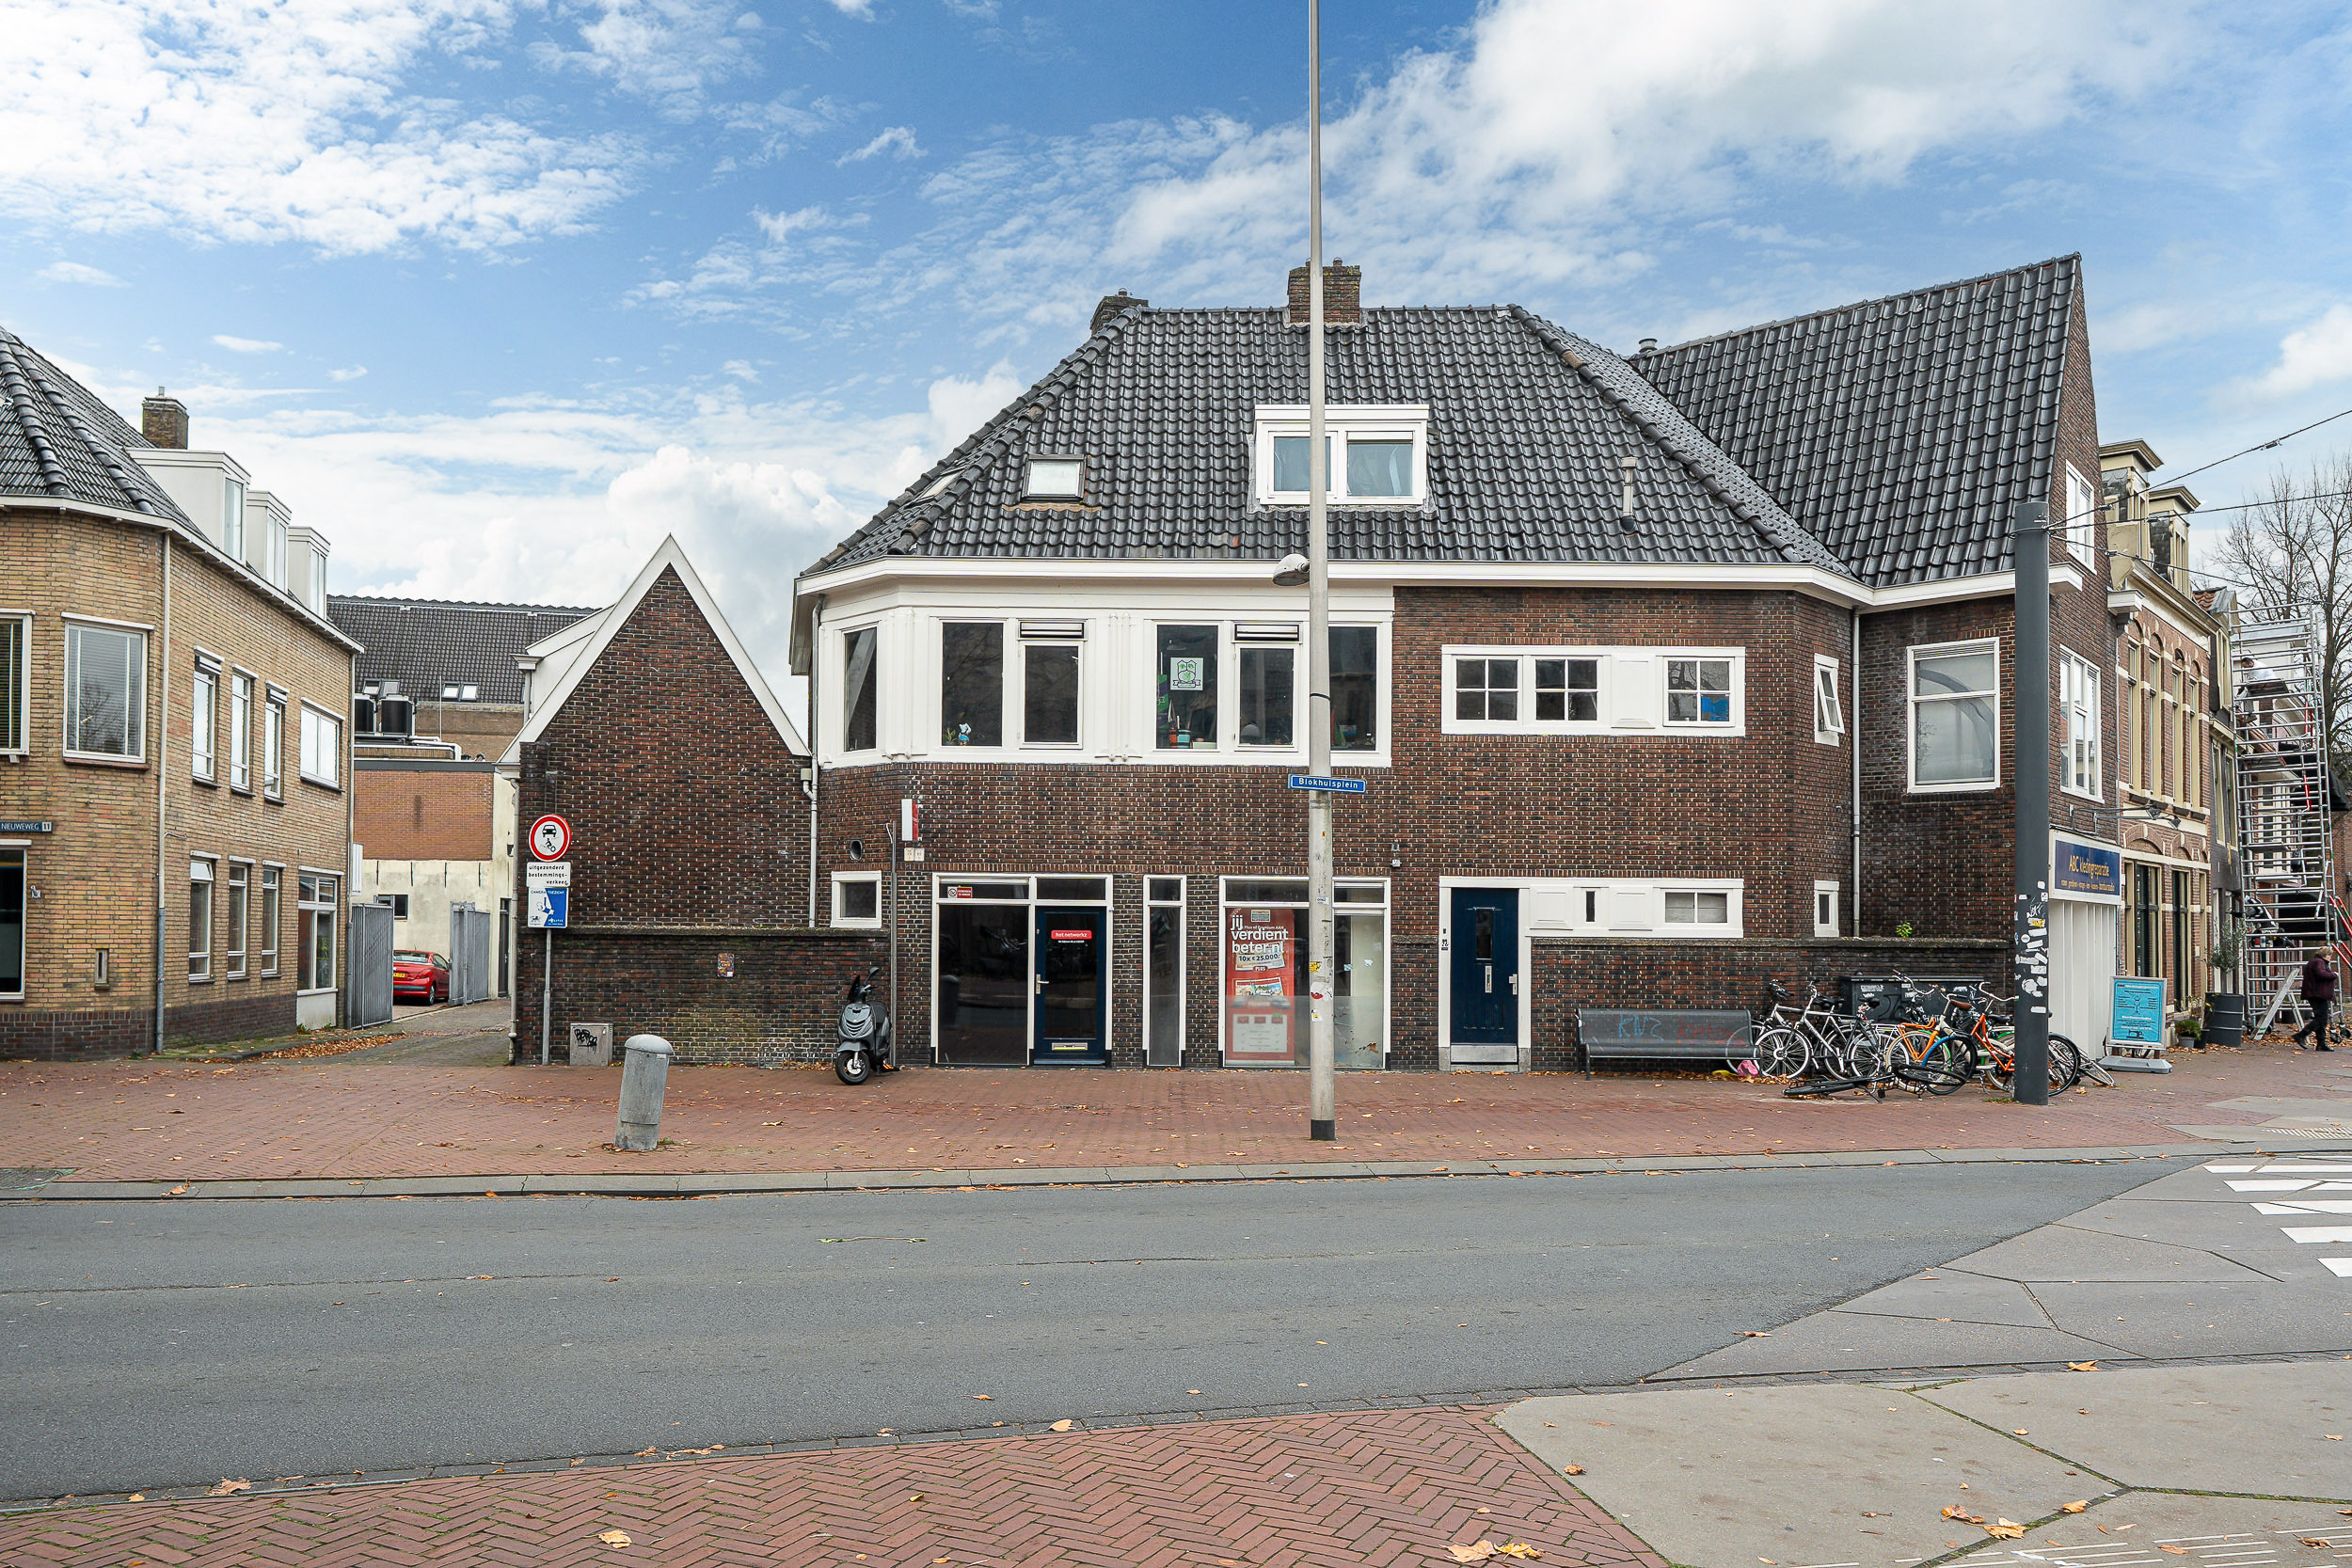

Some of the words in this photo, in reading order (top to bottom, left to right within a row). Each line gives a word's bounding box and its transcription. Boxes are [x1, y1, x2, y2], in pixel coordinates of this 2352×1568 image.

[1298, 777, 1359, 788] Blokhuisplein
[1231, 914, 1244, 930] jij
[1231, 927, 1289, 941] verdient
